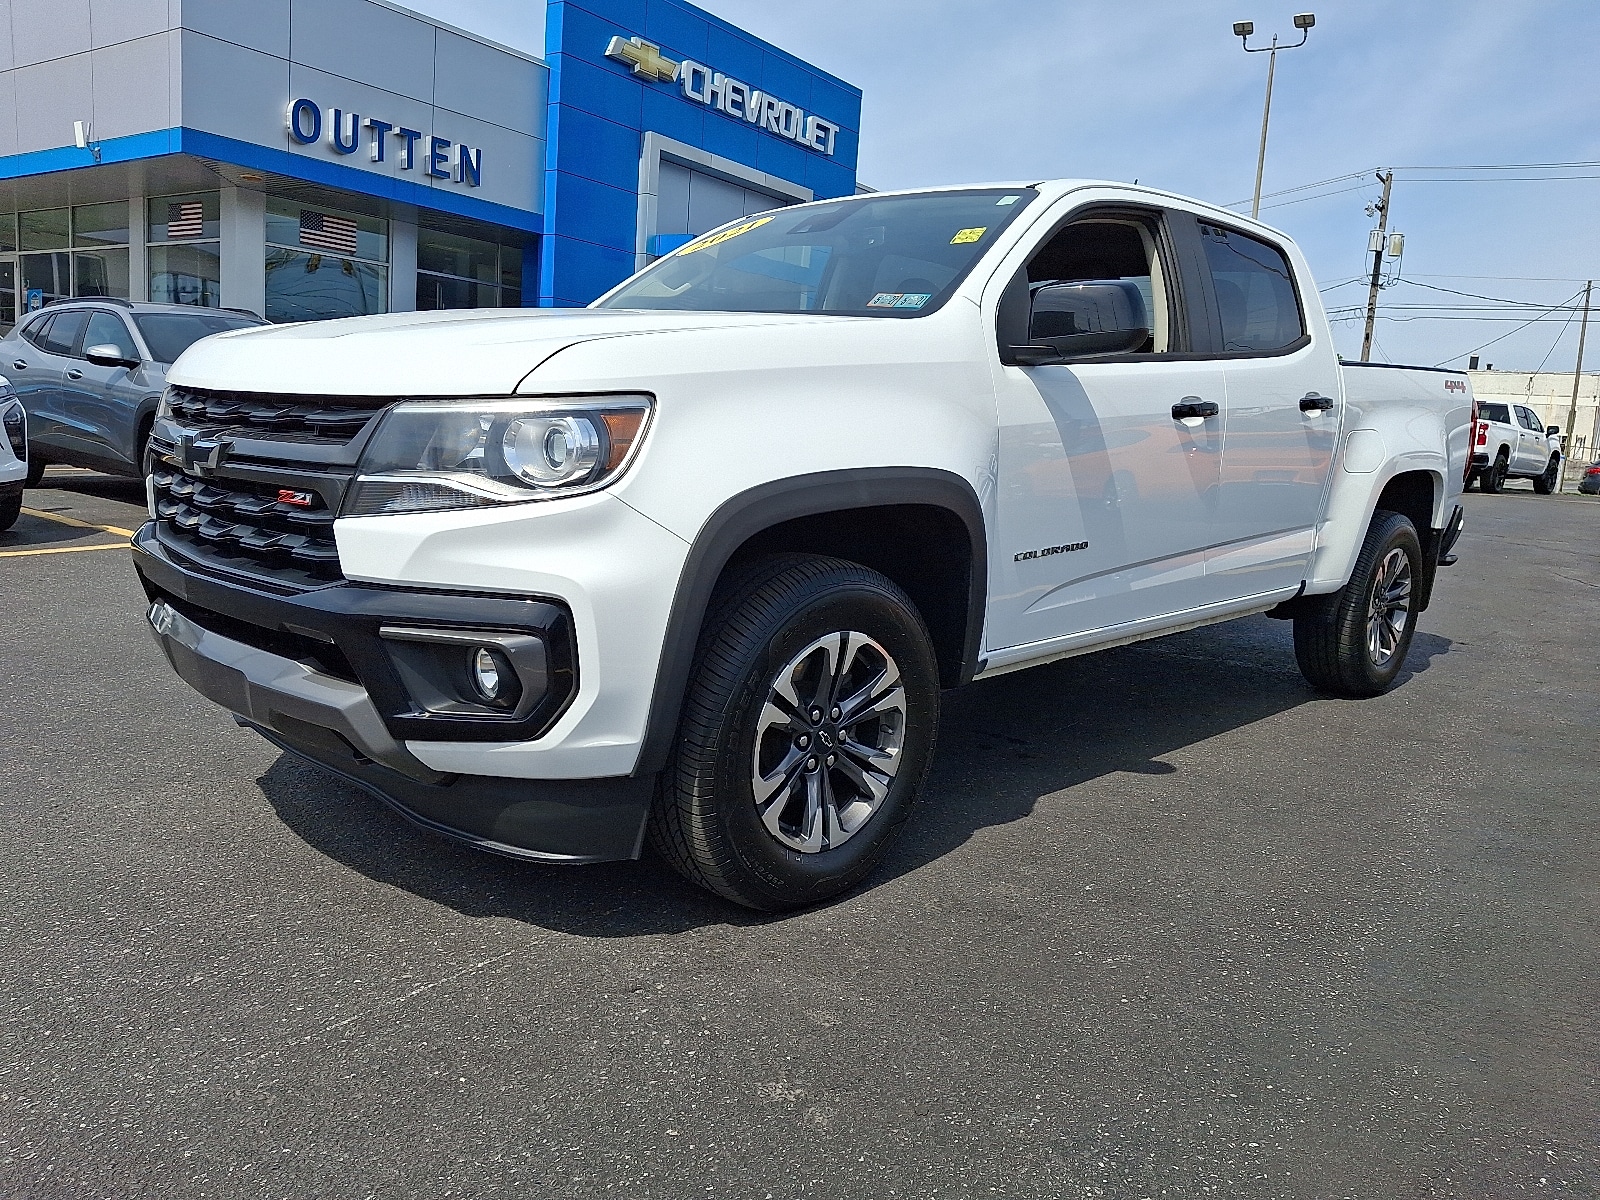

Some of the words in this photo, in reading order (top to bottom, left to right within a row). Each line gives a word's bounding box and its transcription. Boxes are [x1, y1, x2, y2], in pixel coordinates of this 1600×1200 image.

[681, 60, 839, 155] CHEVROLET
[287, 98, 482, 187] OUTTEN
[278, 489, 312, 506] Z71
[1013, 540, 1089, 561] COLORADO
